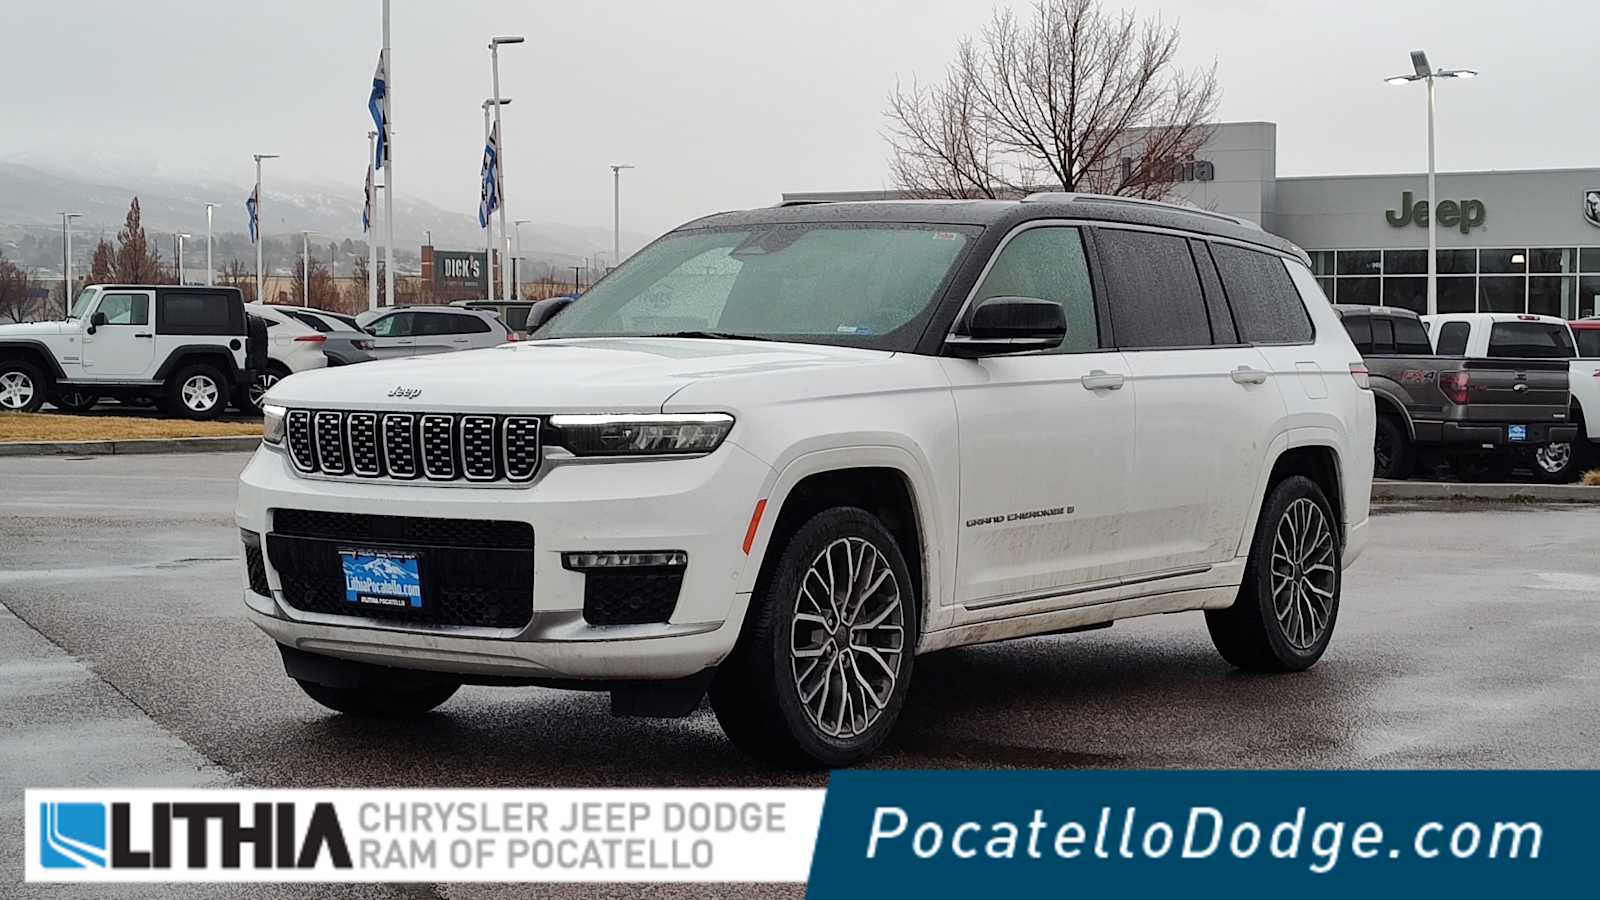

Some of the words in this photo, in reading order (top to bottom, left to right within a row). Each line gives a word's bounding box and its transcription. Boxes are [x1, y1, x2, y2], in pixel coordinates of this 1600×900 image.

[1121, 154, 1215, 182] Lhia
[1386, 191, 1485, 234] Jeep
[444, 255, 480, 278] DICK'S
[387, 385, 422, 400] Jeep
[966, 515, 1005, 527] GRAND
[1007, 507, 1064, 521] CHEROKEE
[345, 575, 420, 597] LithiaPocatello.com
